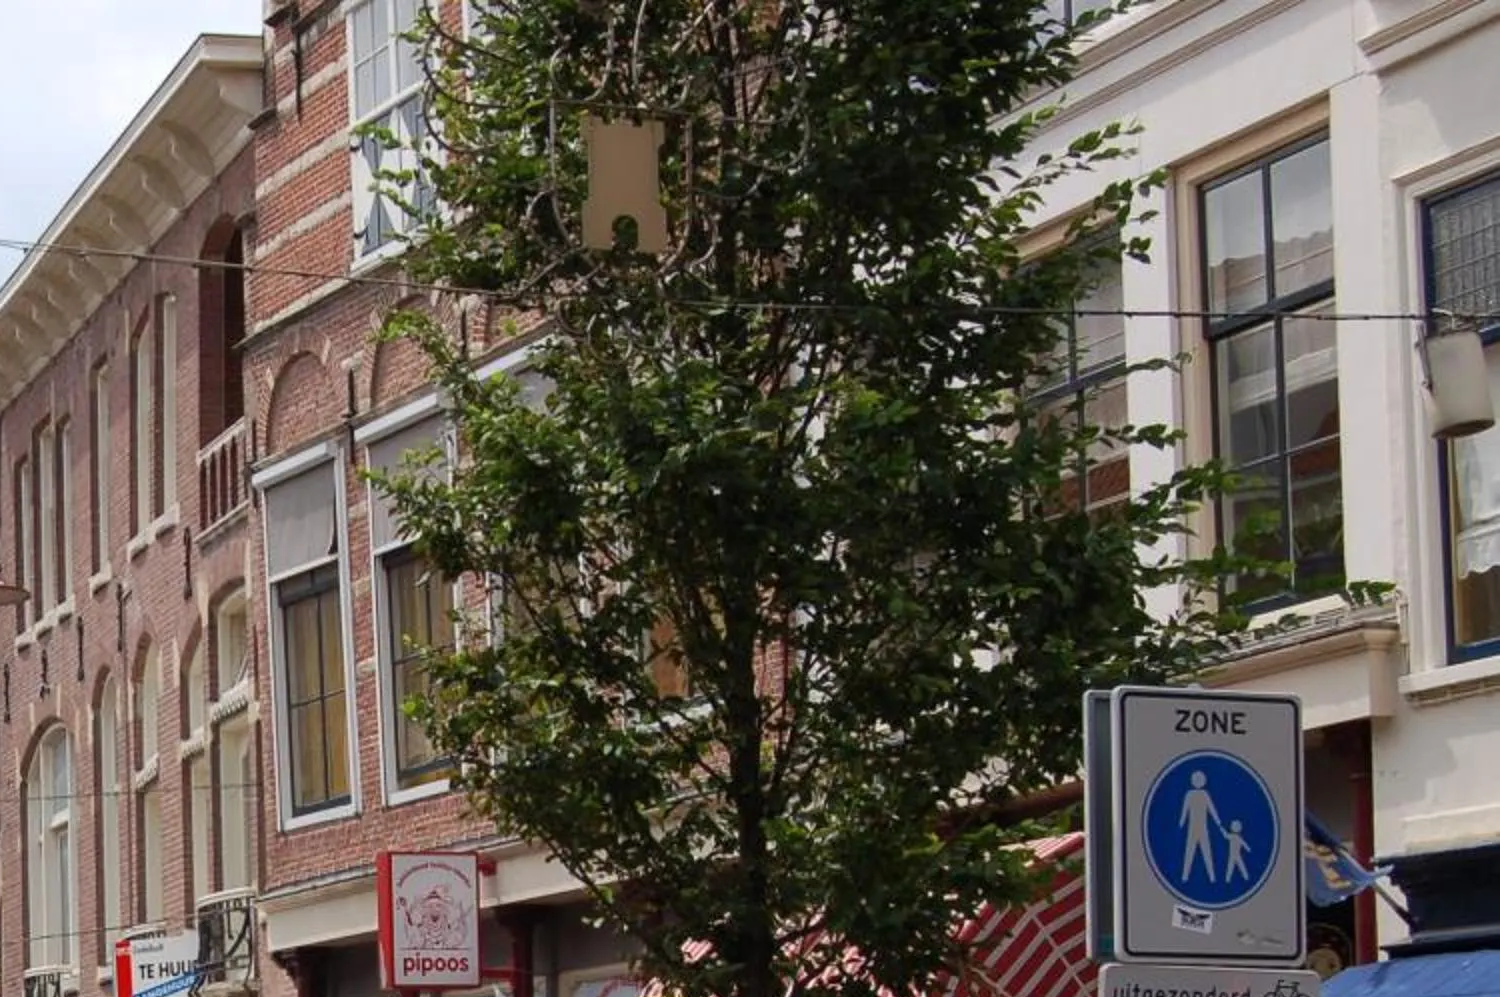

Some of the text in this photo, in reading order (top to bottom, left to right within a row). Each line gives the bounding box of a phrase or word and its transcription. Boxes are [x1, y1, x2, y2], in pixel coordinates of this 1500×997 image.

[1174, 709, 1248, 735] ZONE
[138, 959, 198, 980] TE HUU
[402, 951, 469, 977] pipoos
